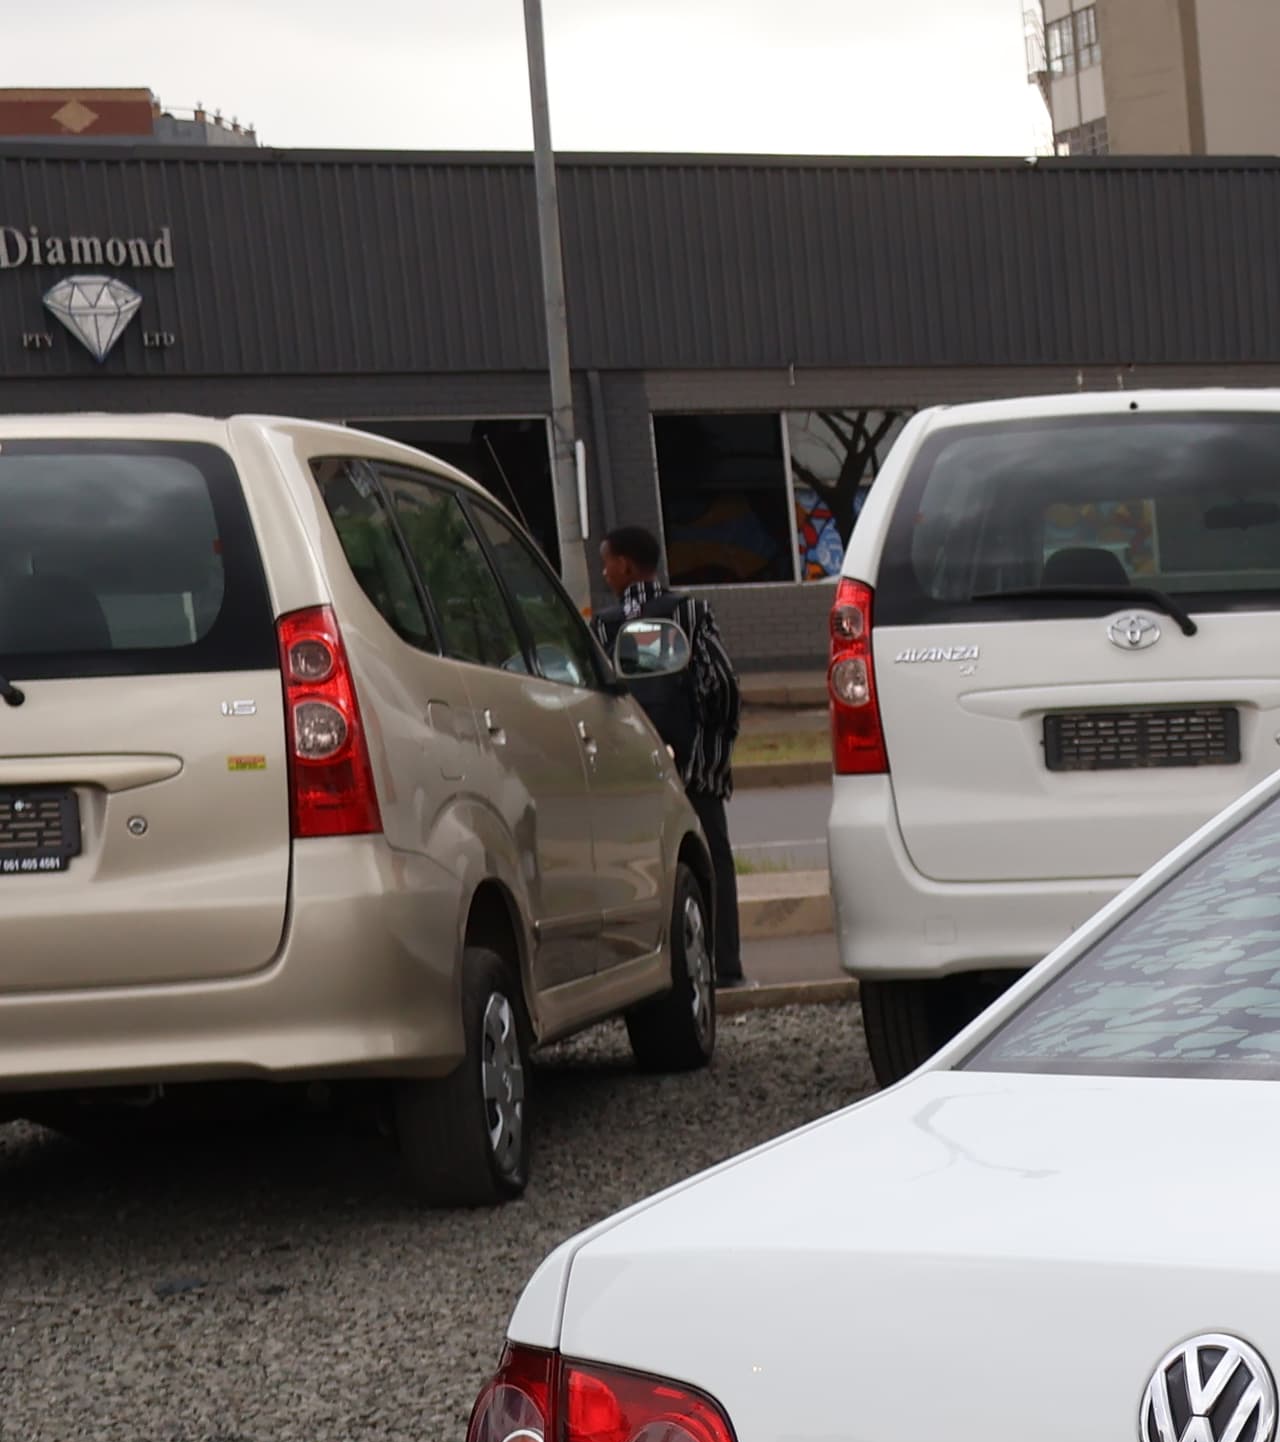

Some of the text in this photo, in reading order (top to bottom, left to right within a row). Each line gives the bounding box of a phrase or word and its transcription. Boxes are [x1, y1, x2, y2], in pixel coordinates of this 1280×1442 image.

[0, 225, 175, 269] Diamond
[22, 330, 175, 348] PTY LTD
[895, 644, 979, 663] AVANZA
[221, 700, 257, 716] 1.5
